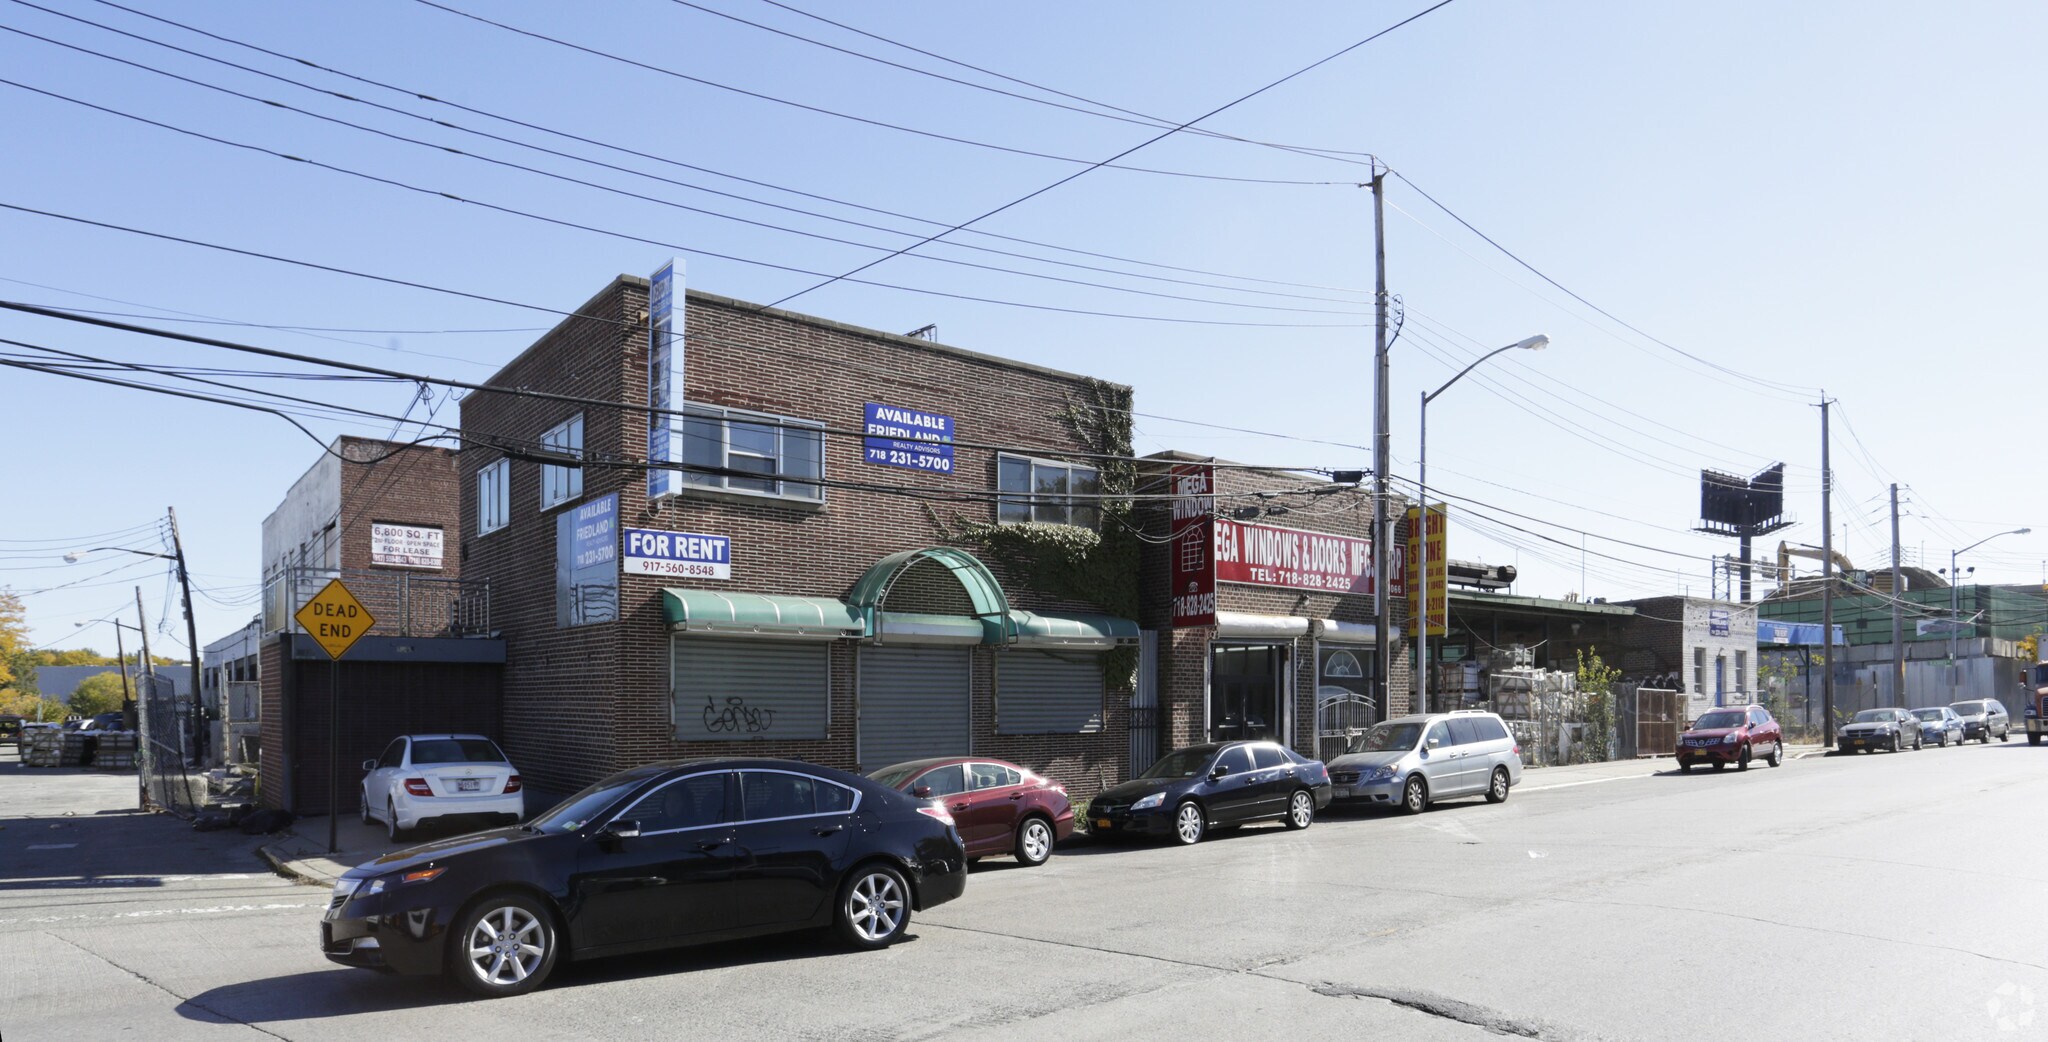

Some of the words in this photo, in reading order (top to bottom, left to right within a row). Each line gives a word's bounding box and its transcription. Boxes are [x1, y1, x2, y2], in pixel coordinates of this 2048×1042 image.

[876, 407, 945, 430] AVAILABLE
[892, 441, 914, 450] REALTY
[914, 445, 940, 454] ADVISORS
[869, 449, 886, 460] 718
[890, 450, 950, 471] 231-5700
[1177, 472, 1207, 495] MEGA
[580, 498, 611, 522] AVAILABLE
[374, 527, 403, 538] 6,800
[406, 529, 424, 539] SQ.
[427, 531, 440, 540] FT
[576, 519, 609, 542] FRIEDLAND
[1408, 514, 1443, 539] BRGHT
[403, 547, 430, 555] LEASE
[585, 544, 614, 565] 231-5700
[630, 532, 670, 557] FOR
[675, 536, 725, 561] RENT
[1215, 522, 1239, 563] EGA
[1243, 526, 1299, 570] WINDOWS
[1302, 535, 1310, 571] &
[1311, 536, 1347, 575] DOORS
[642, 560, 715, 576] 917-560-8548
[1250, 567, 1277, 582] TEL:
[1278, 570, 1351, 590] 718-828-2425
[314, 602, 358, 618] DEAD
[1173, 592, 1214, 617] 718-828-2425
[320, 623, 351, 638] END
